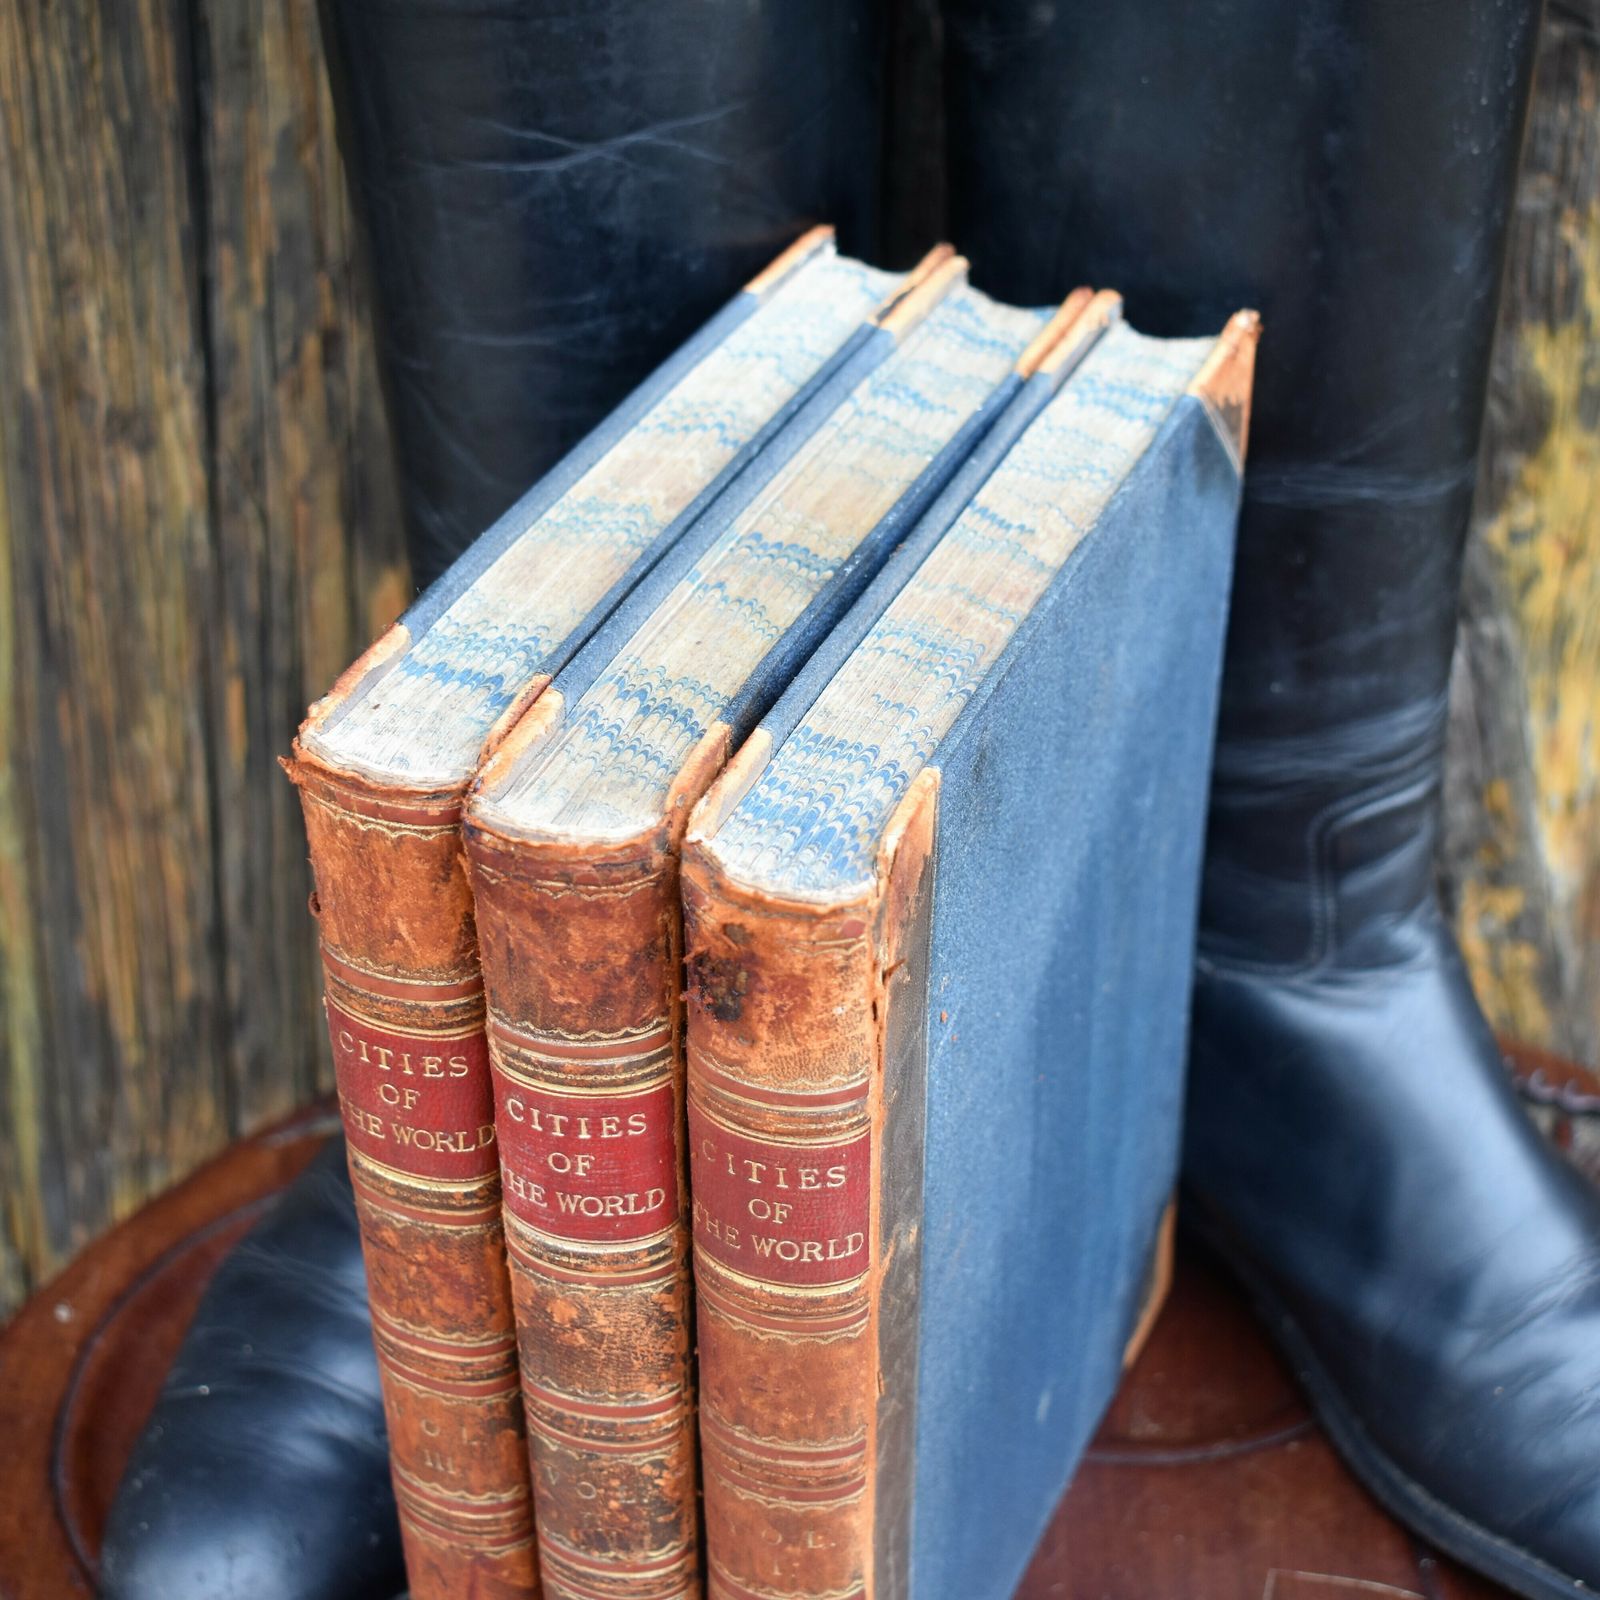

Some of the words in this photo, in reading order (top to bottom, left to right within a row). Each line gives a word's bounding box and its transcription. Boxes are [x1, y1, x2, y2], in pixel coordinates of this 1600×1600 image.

[339, 1031, 469, 1078] CITIES
[379, 1083, 421, 1110] OF
[505, 1098, 647, 1140] CITIES
[391, 1123, 497, 1153] WORLD
[547, 1152, 595, 1177] OF
[702, 1138, 847, 1190] CITIES
[555, 1188, 666, 1218] WORLD
[748, 1198, 793, 1225] OF
[751, 1232, 865, 1263] WORLD
